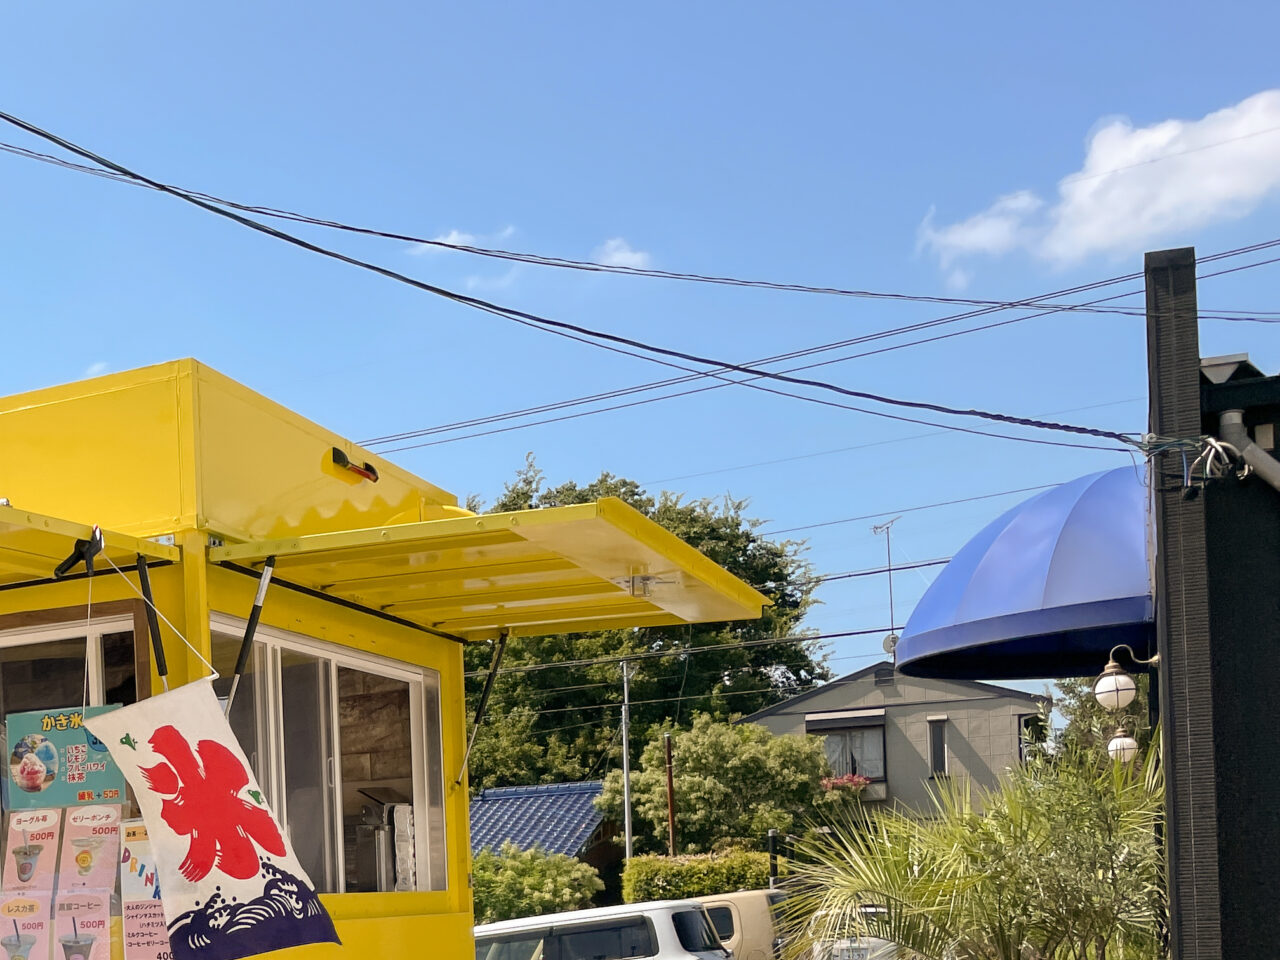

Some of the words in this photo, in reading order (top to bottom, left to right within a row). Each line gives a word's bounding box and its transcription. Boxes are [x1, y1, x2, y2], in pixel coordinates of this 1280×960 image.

[92, 827, 118, 835] 500円
[29, 832, 54, 841] 500円
[21, 922, 44, 930] 500円
[80, 920, 106, 929] 500円
